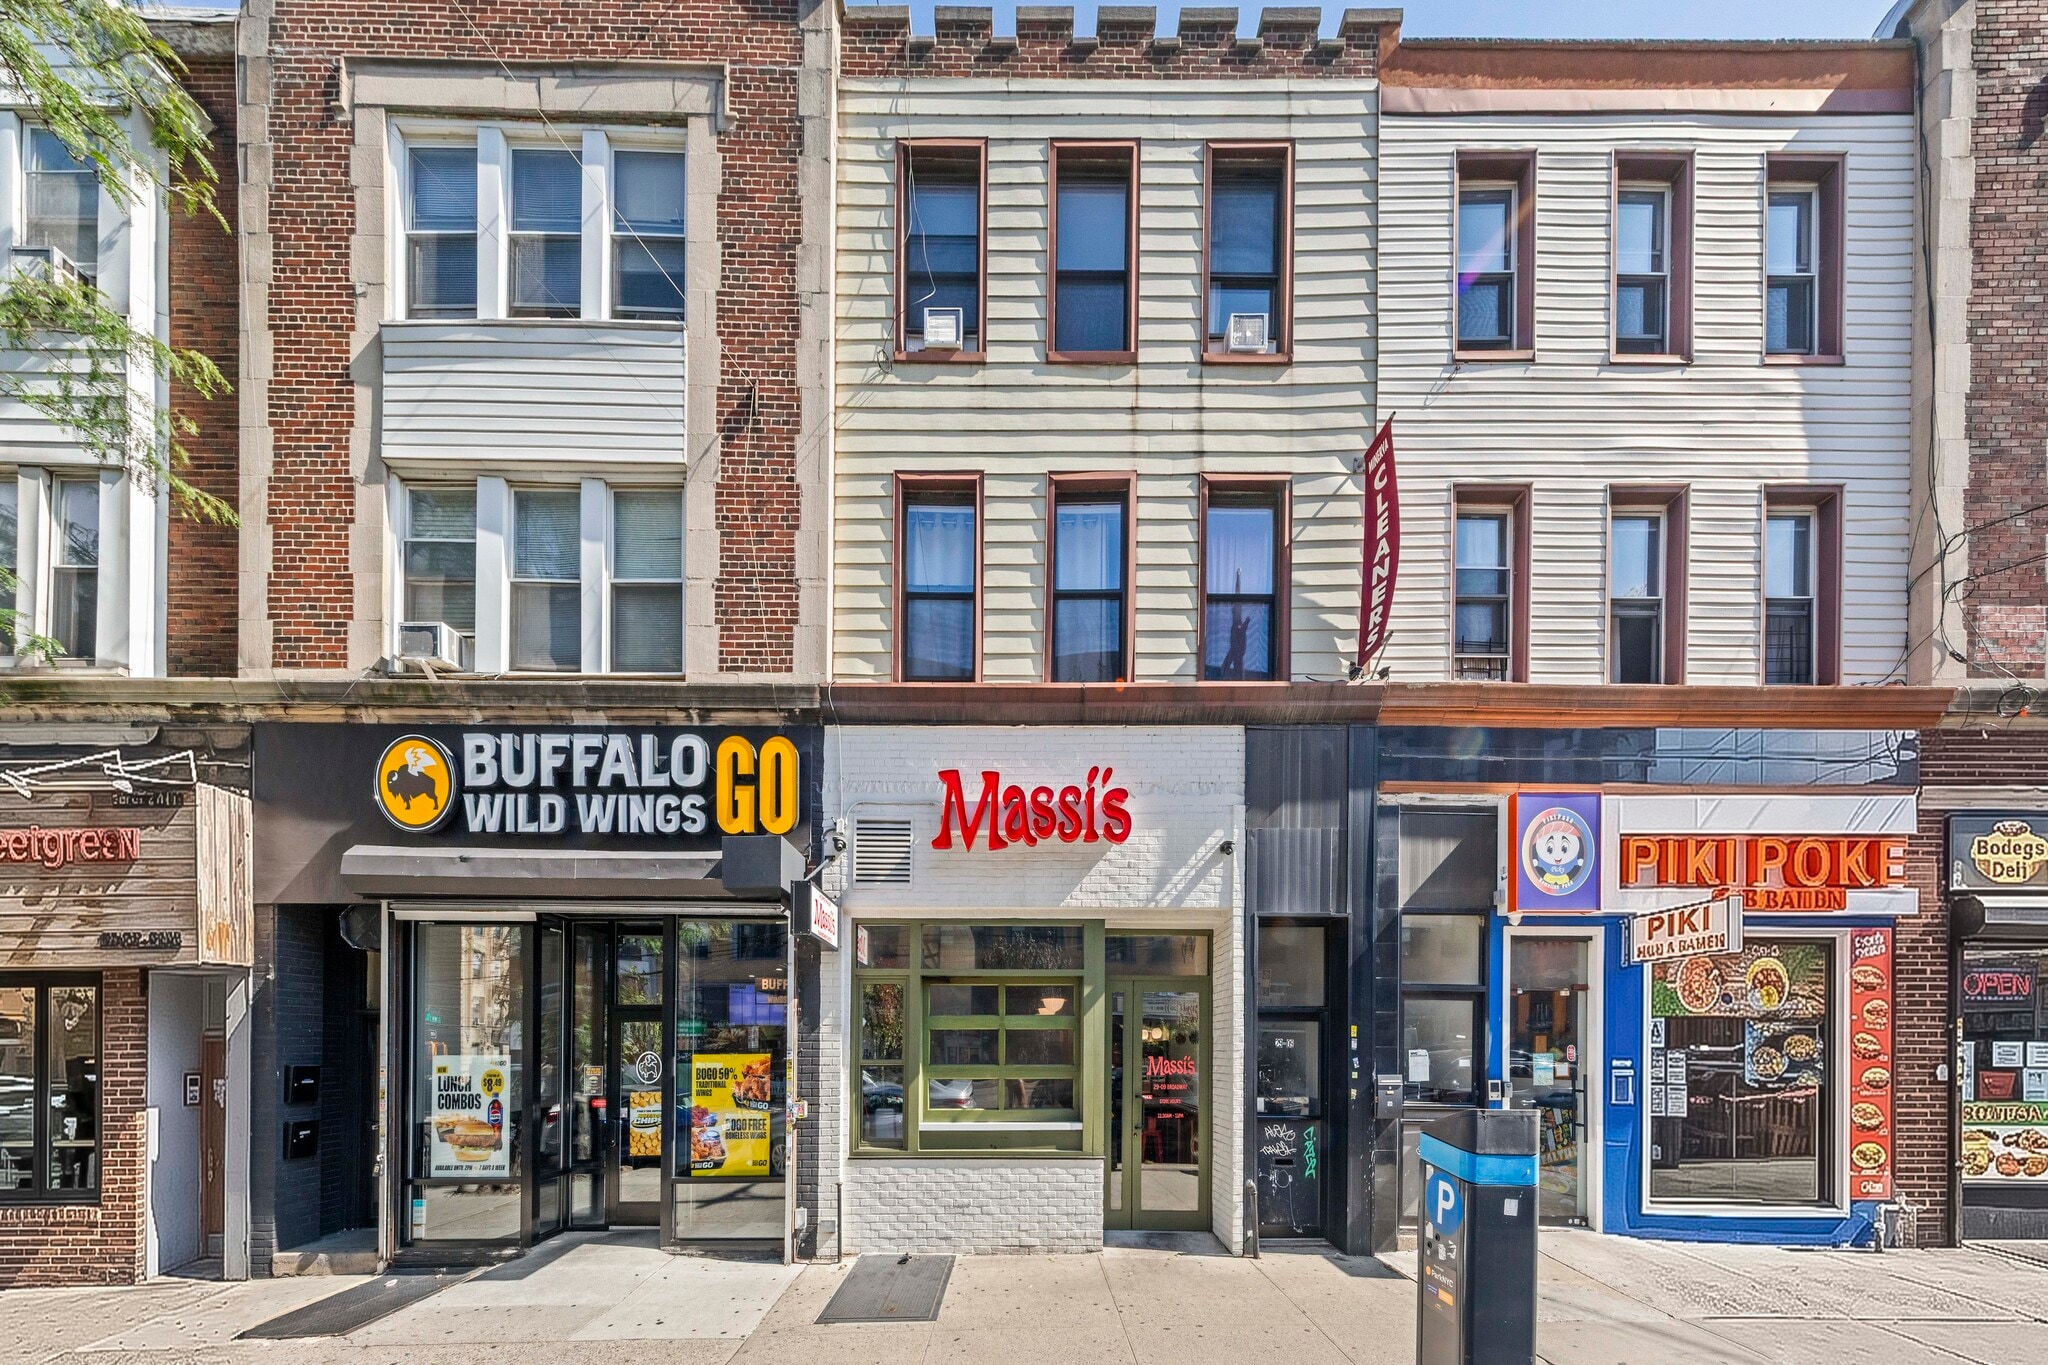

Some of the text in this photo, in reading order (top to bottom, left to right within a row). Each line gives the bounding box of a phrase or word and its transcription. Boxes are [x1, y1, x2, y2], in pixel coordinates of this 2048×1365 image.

[1364, 462, 1391, 652] CLEANERS
[463, 732, 708, 788] BUFFALO
[716, 735, 799, 835] GO
[463, 794, 708, 834] WILD WINGS
[931, 765, 1132, 852] Massi's
[1628, 838, 1908, 886] PIKI POKE
[1647, 905, 1710, 941] PIKI
[1963, 972, 2032, 996] OPEN
[438, 1076, 472, 1092] LUNCH
[696, 1068, 718, 1080] BOGO
[437, 1093, 482, 1110] COMBOS
[748, 1118, 767, 1131] FREE
[1437, 1179, 1456, 1225] P
